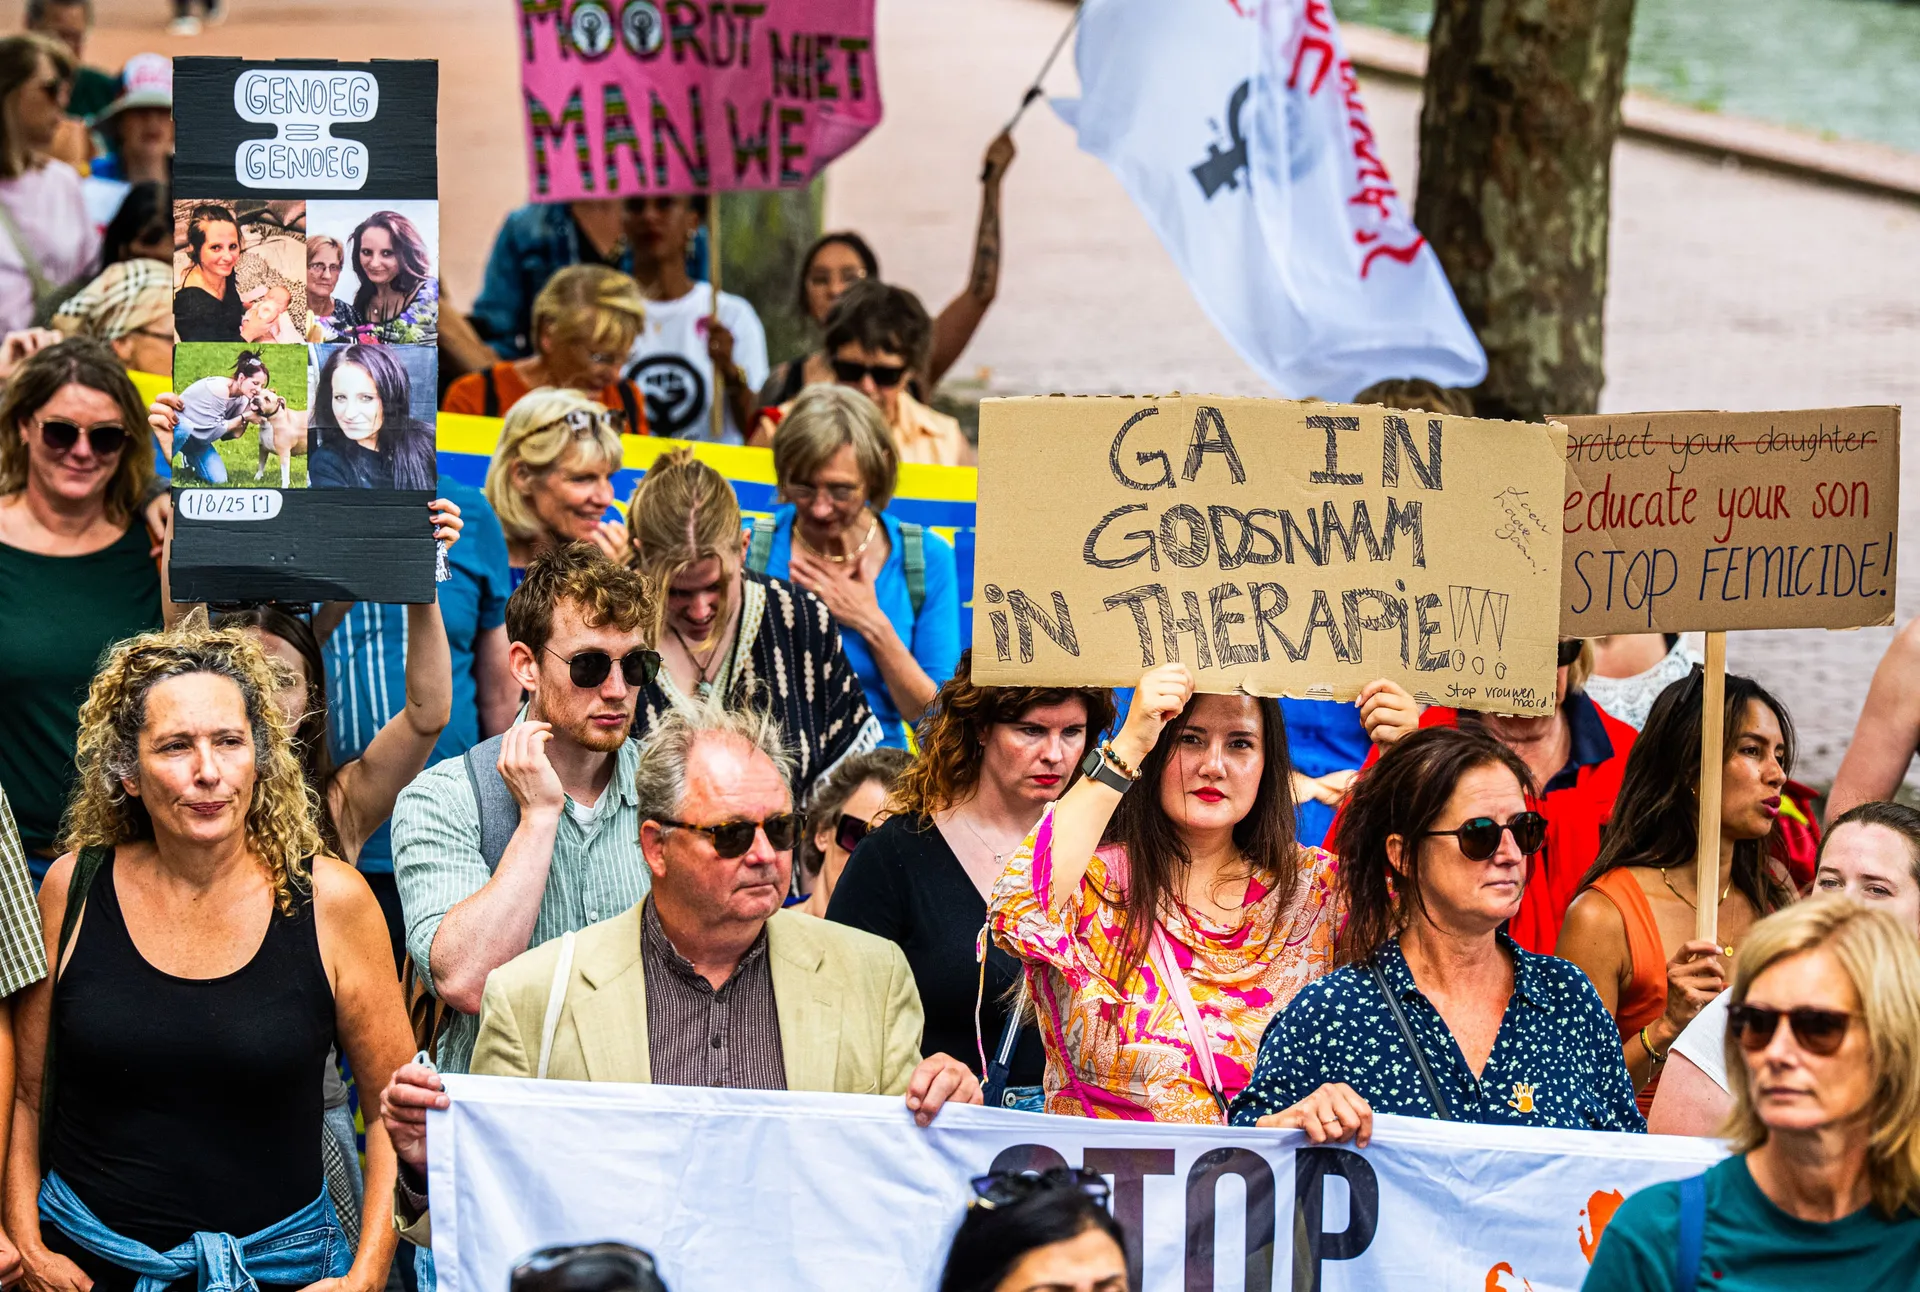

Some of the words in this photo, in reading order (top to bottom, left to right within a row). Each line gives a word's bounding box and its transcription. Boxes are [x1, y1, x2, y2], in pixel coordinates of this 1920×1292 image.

[768, 29, 870, 101] NIET
[245, 75, 370, 117] GENOEG
[245, 144, 359, 180] GENOEG
[524, 83, 710, 194] MAN
[725, 99, 804, 184] WE
[1109, 405, 1246, 491] GA
[1305, 415, 1443, 490] IN
[1755, 425, 1877, 462] daughter
[188, 493, 245, 515] 1/8/25
[1562, 472, 1698, 533] educate
[1812, 481, 1869, 518] son
[1084, 496, 1426, 571] GODSNAAM
[1571, 548, 1679, 628] STOP
[1699, 531, 1893, 602] FEMICIDE!
[1445, 682, 1476, 699] Stop
[1485, 687, 1535, 699] vrouwen
[1512, 692, 1554, 708] moord!
